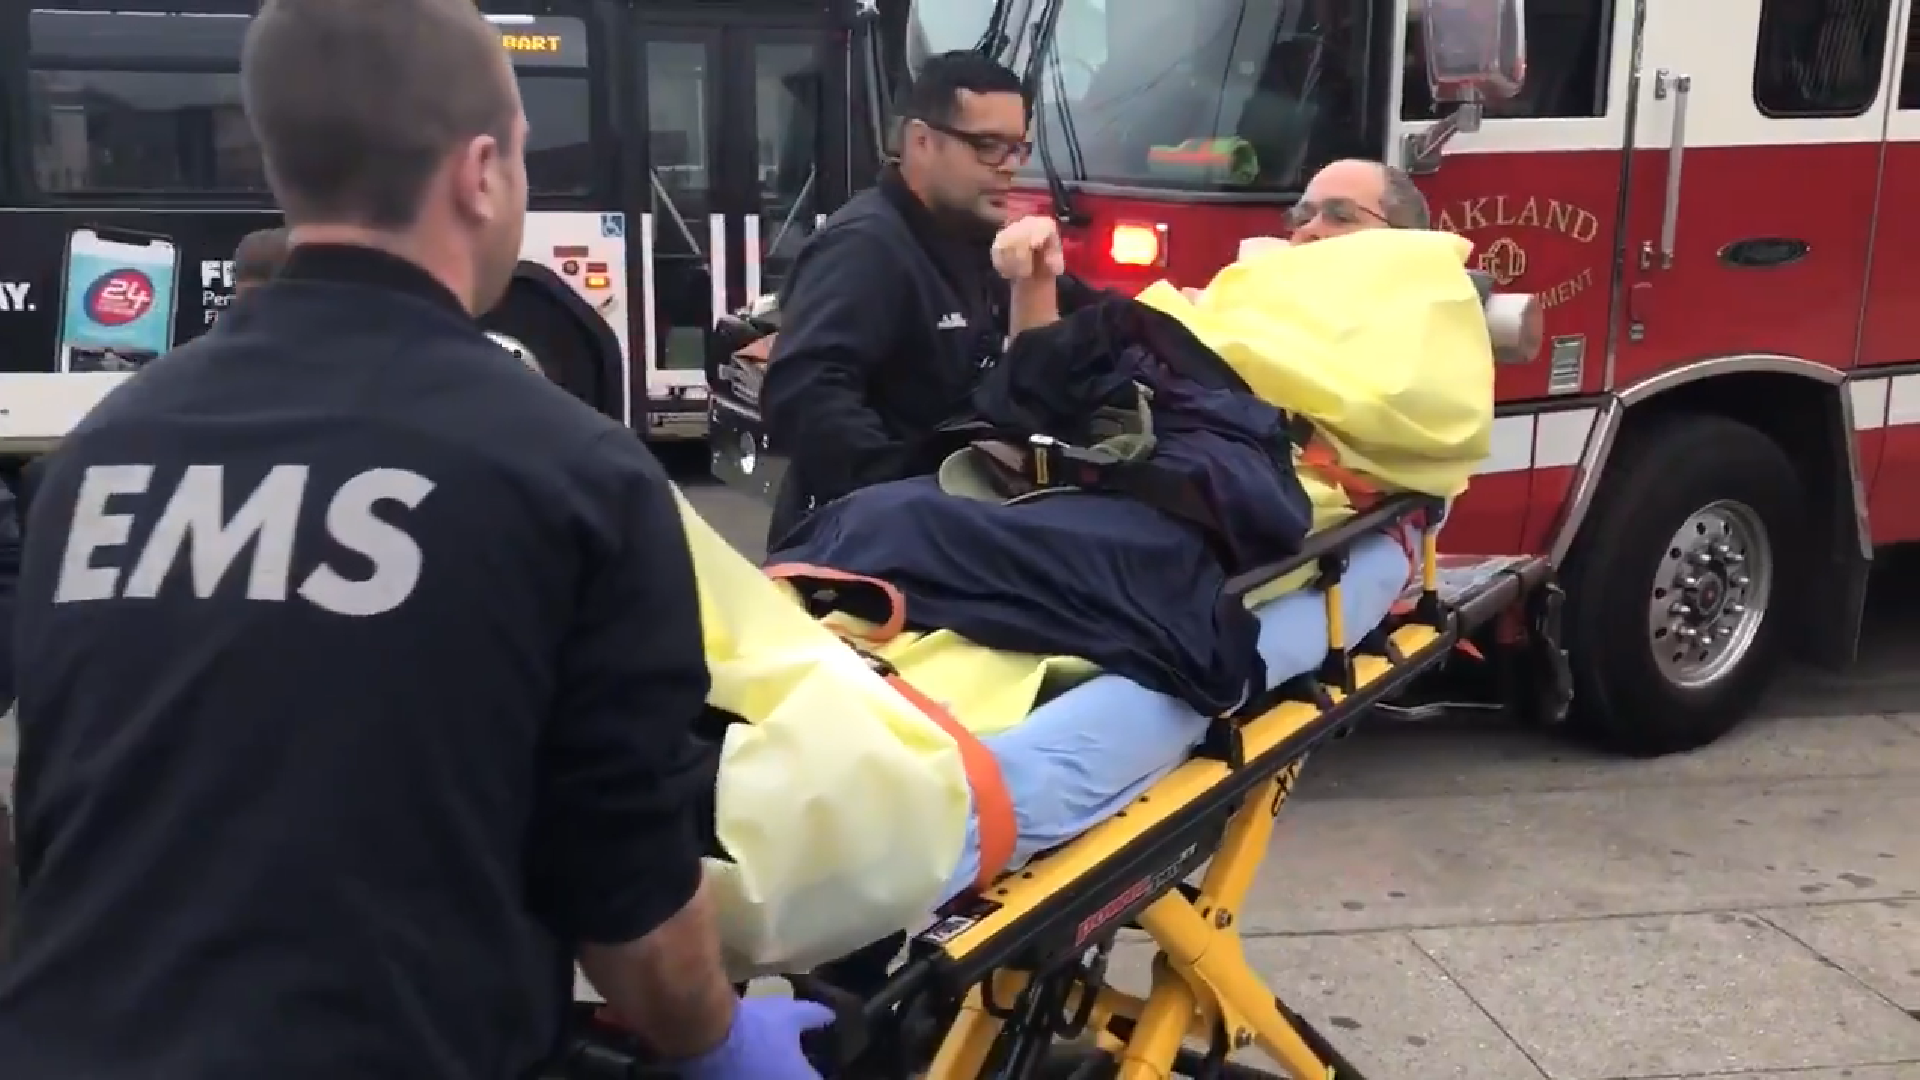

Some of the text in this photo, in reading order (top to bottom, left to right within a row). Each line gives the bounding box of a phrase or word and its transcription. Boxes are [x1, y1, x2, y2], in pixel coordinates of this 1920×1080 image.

[502, 35, 561, 52] BART
[1437, 195, 1599, 243] AKLAND
[101, 278, 150, 310] 24
[202, 290, 236, 306] Per
[1536, 268, 1593, 310] MENT
[54, 464, 437, 616] EMS
